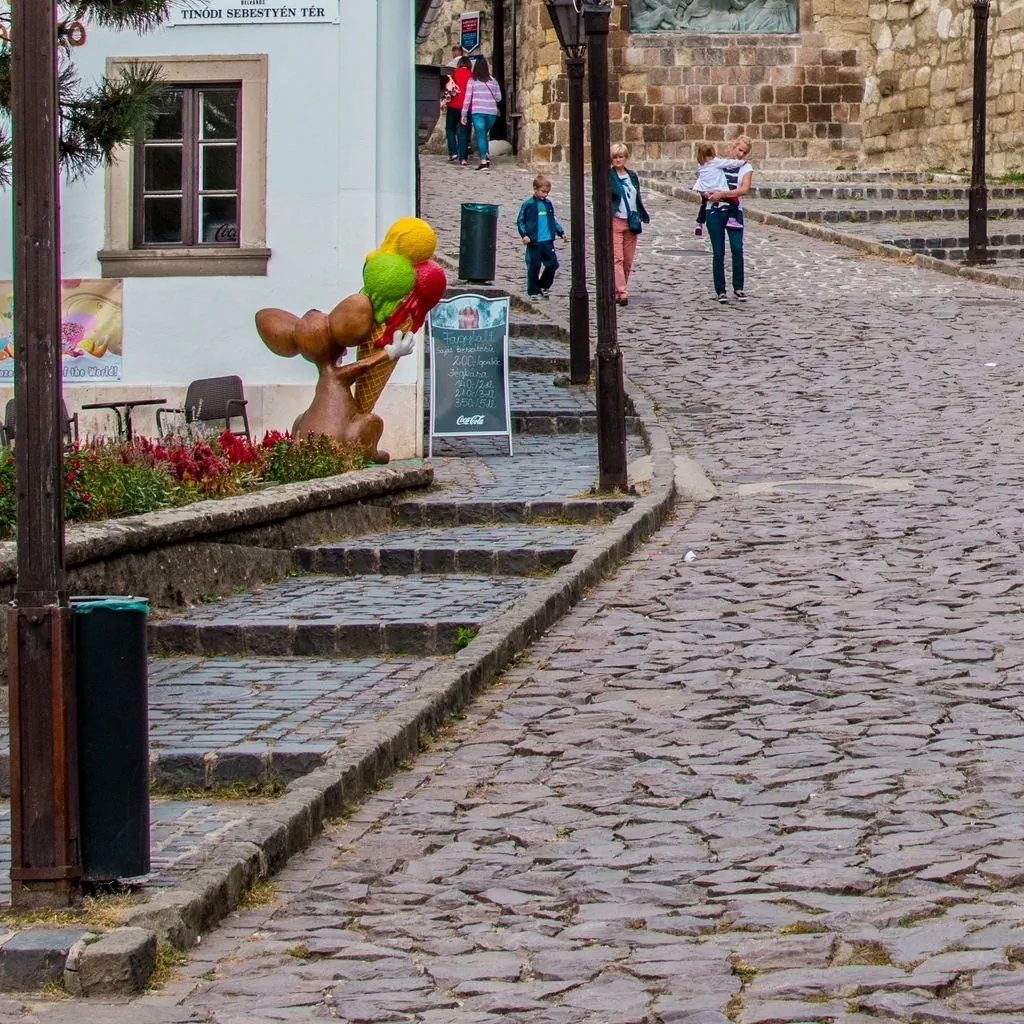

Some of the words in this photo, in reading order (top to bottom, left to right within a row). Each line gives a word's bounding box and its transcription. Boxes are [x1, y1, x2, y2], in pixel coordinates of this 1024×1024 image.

[181, 7, 222, 19] TINÓDI
[226, 5, 297, 18] SEBESTYÉN
[301, 5, 325, 17] TÉR
[71, 366, 85, 377] the
[88, 365, 118, 377] World!
